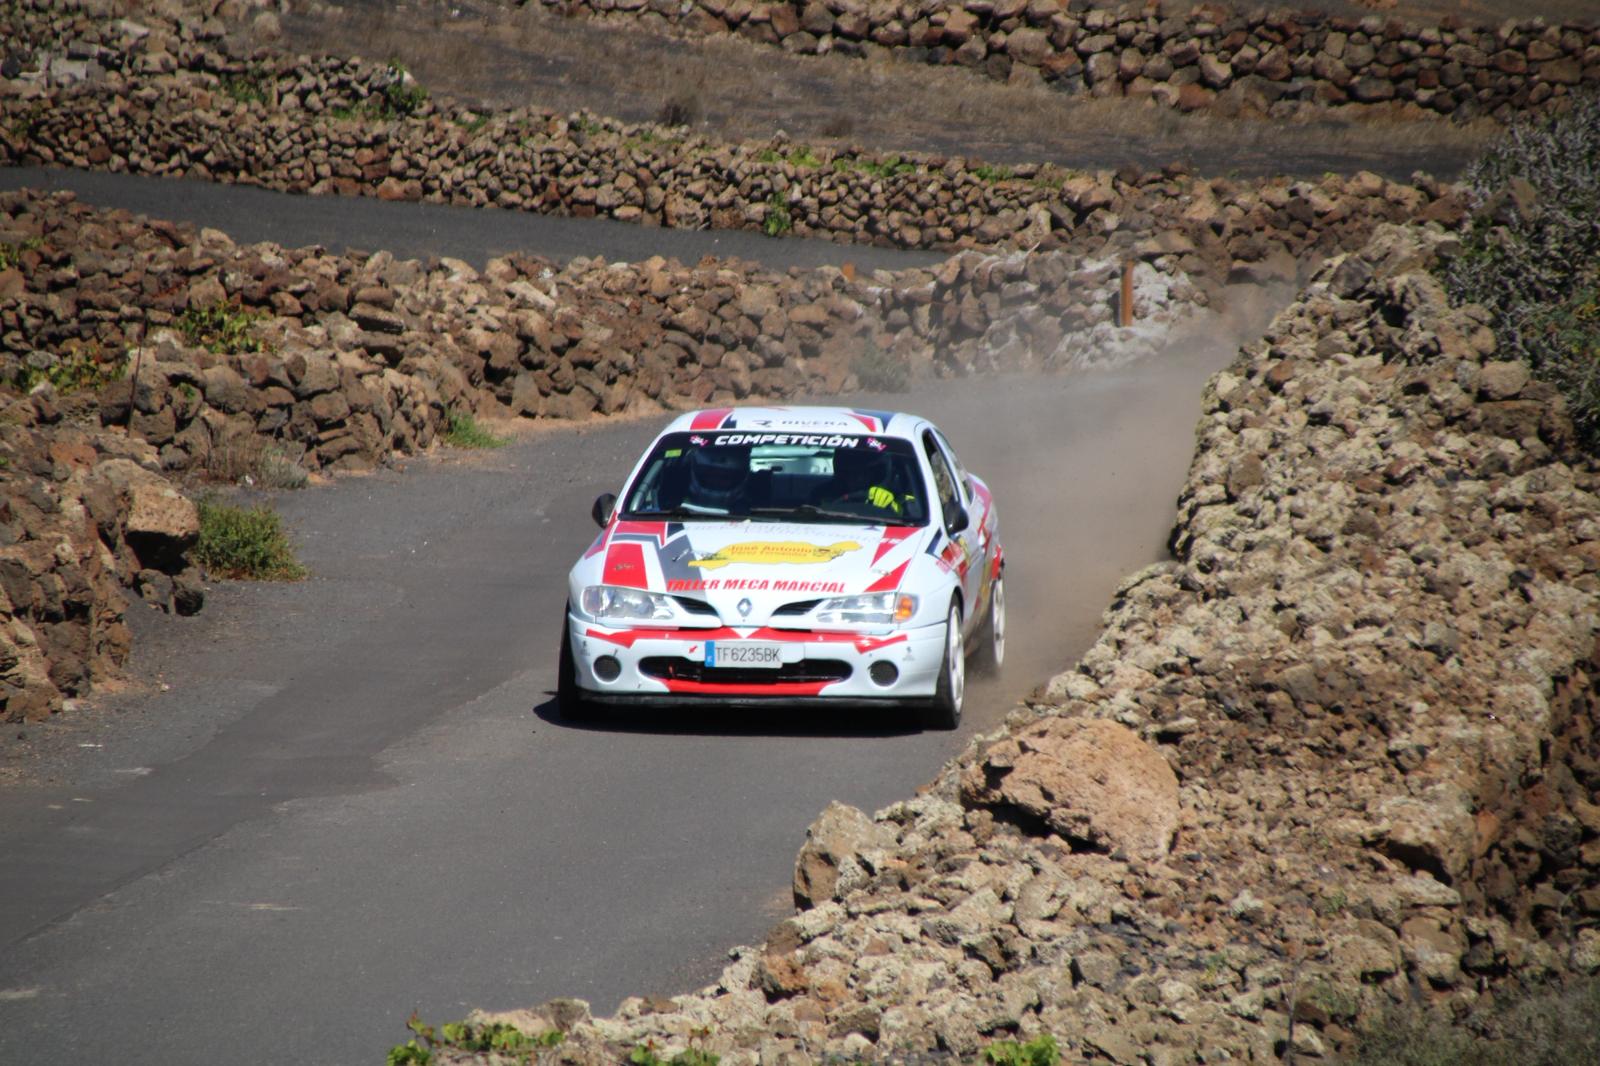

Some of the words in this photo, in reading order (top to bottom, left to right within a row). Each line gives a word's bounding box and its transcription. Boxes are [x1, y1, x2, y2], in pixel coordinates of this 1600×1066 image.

[714, 434, 859, 448] COMPETICIÓN
[667, 579, 719, 592] TALLER
[723, 579, 769, 591] MECA
[773, 580, 846, 593] MARCIAL
[716, 647, 780, 662] TF6235BK
